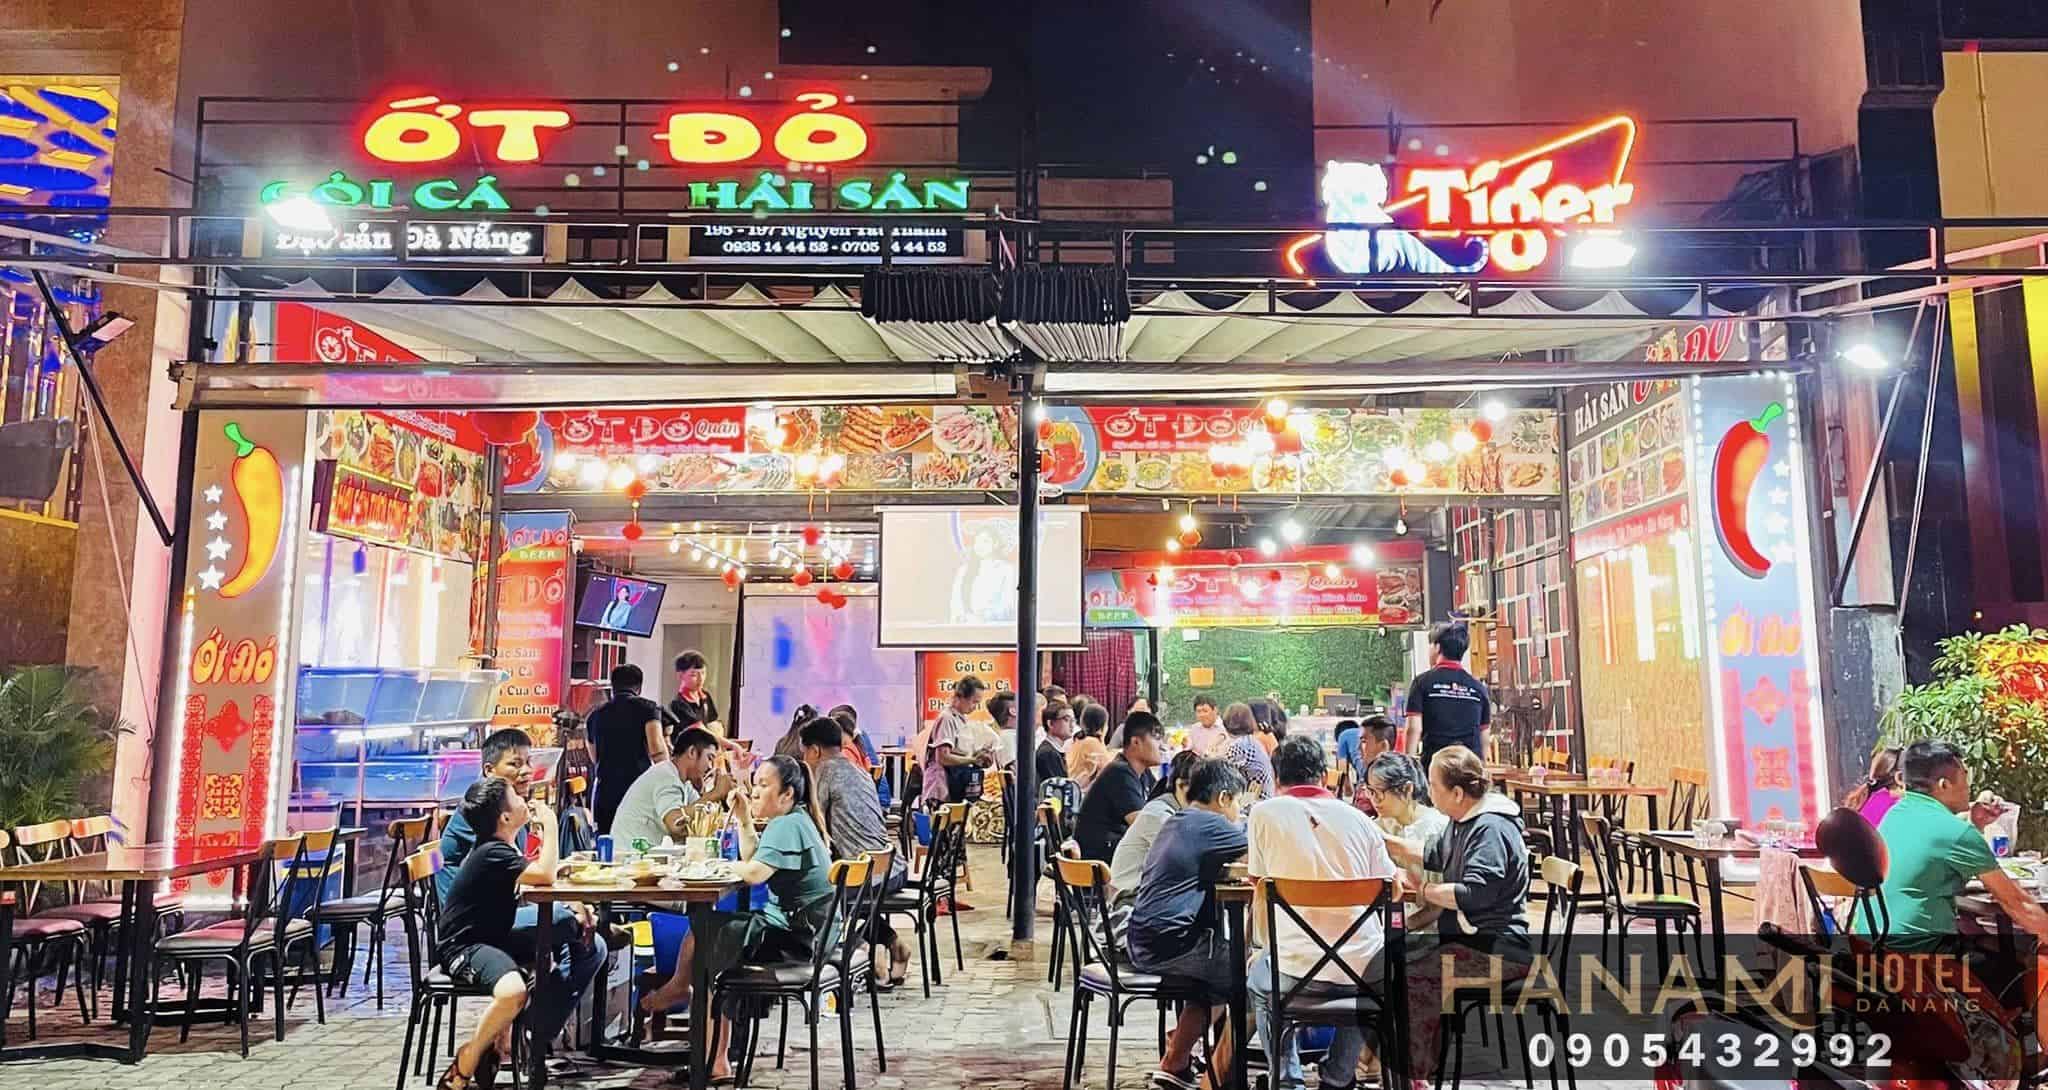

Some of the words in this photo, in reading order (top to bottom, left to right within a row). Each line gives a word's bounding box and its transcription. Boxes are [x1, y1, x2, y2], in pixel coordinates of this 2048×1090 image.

[363, 95, 571, 163] ỚT
[652, 92, 868, 163] ĐỎ
[412, 175, 511, 211] CÁ
[687, 171, 814, 210] HẢI
[837, 172, 971, 210] SẢN
[1408, 160, 1634, 271] Tiger
[722, 240, 761, 253] 0935
[763, 240, 783, 253] 14
[785, 240, 806, 253] 44
[808, 240, 830, 253] 52
[841, 240, 880, 253] 0705
[903, 240, 925, 253] 44
[927, 240, 948, 253] 52
